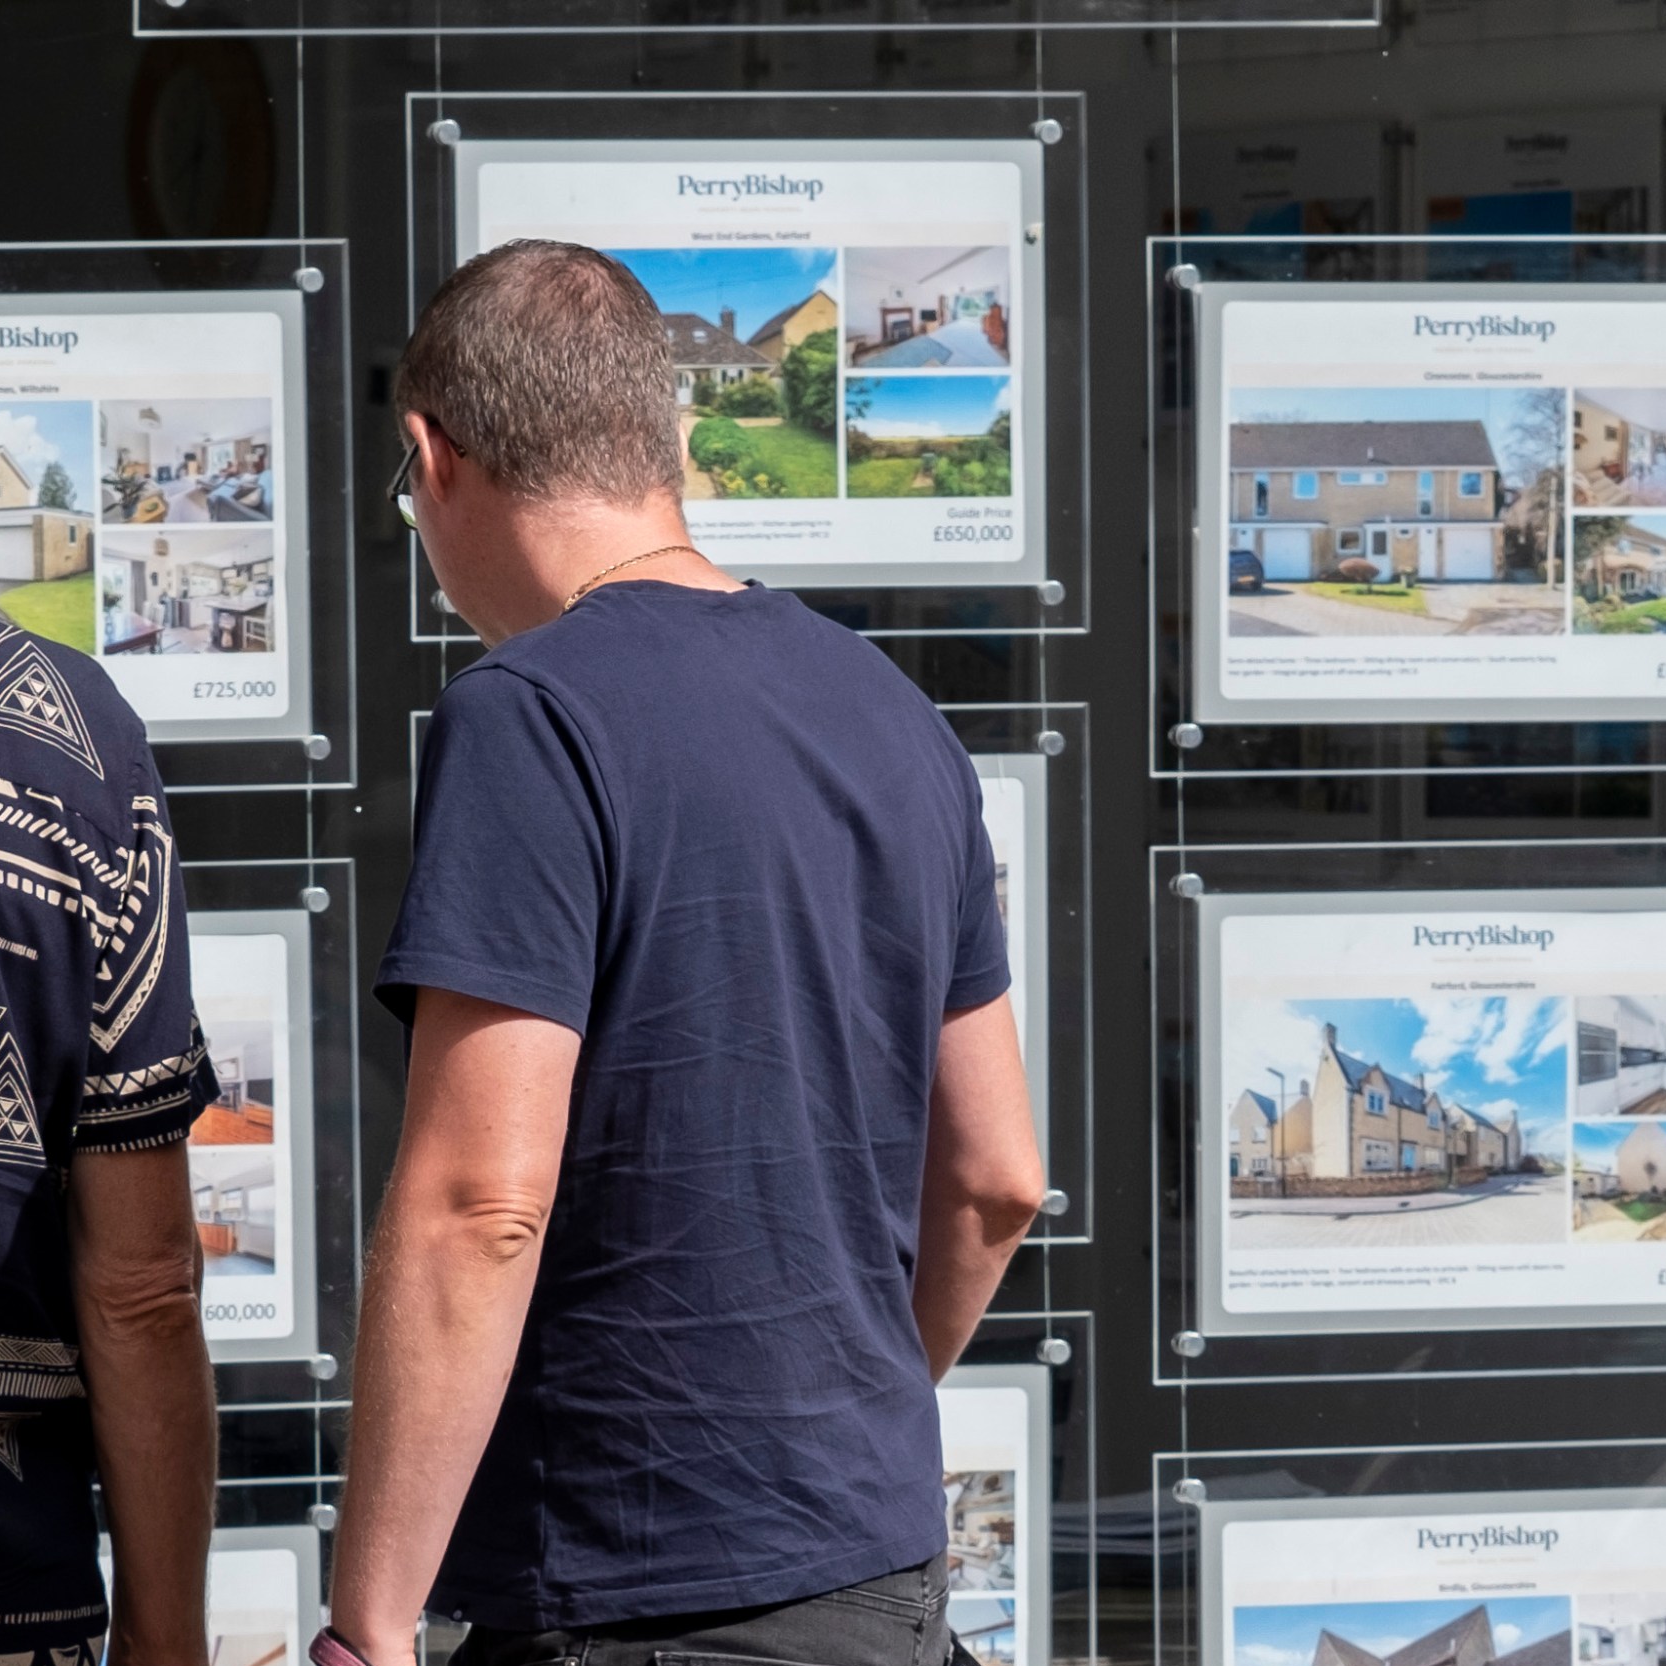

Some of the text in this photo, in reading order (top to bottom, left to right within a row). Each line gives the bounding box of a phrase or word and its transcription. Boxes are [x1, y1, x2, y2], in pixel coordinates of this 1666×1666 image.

[677, 174, 824, 202] PerryBishop
[691, 231, 714, 242] West
[716, 231, 733, 242] End
[775, 229, 811, 241] Fairford
[1413, 314, 1556, 342] PerryBishop
[19, 383, 60, 394] Wiltshire
[947, 506, 1014, 519] Guide Price
[932, 524, 1014, 543] £650,000
[192, 680, 276, 700] £725,000
[1412, 924, 1555, 952] PerryBishop
[204, 1303, 276, 1323] 600,000
[1416, 1525, 1559, 1554] PerryBishop
